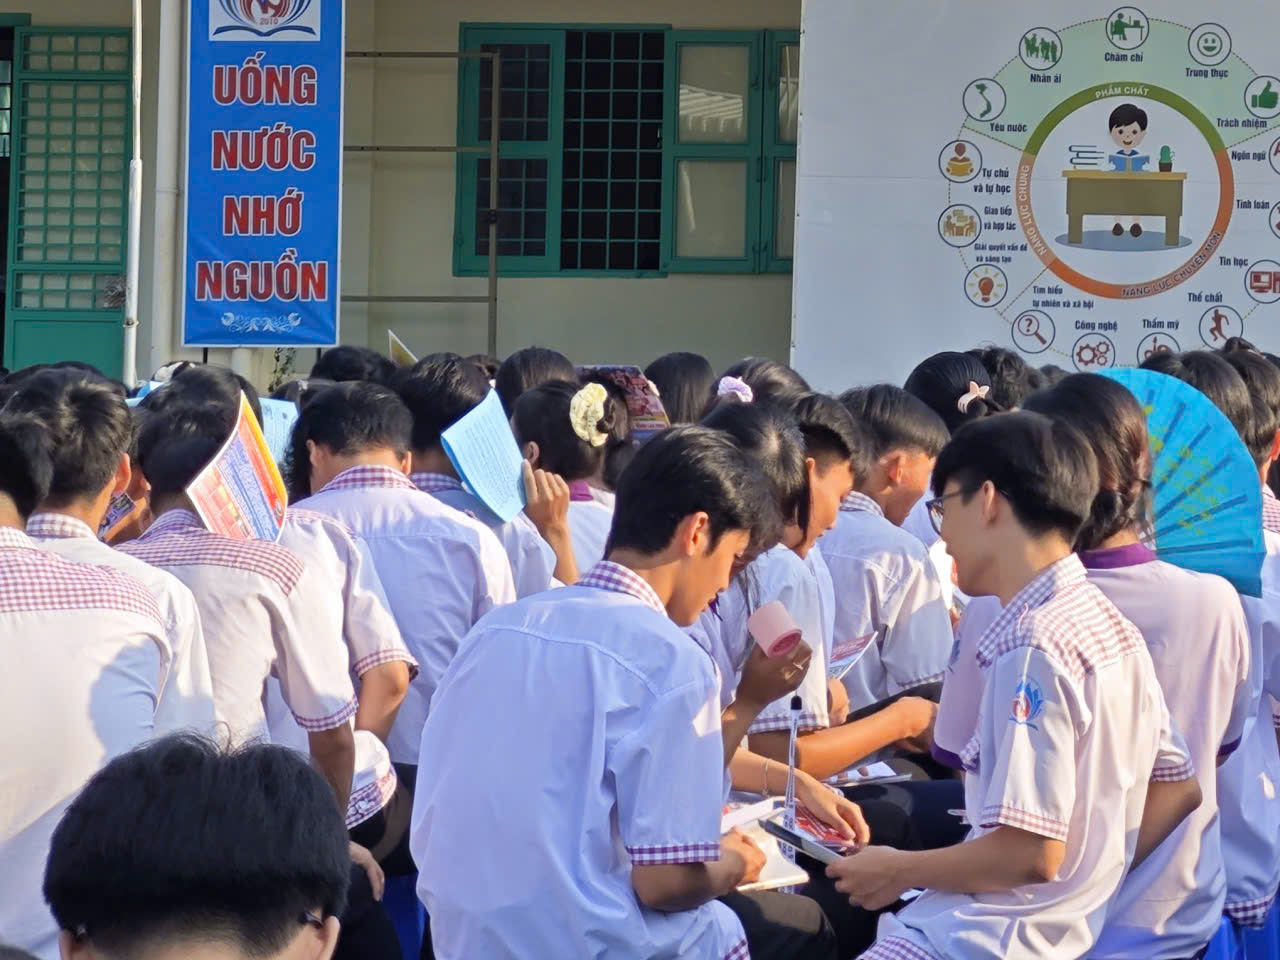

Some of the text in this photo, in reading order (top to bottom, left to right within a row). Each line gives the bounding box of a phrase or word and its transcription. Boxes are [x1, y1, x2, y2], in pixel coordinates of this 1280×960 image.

[260, 18, 279, 26] 2010
[212, 51, 318, 106] UỐNG
[1186, 68, 1208, 78] Trung
[1217, 118, 1267, 130] Trách nhiệm
[210, 123, 317, 171] NƯỚC
[973, 184, 983, 193] và
[996, 183, 1011, 195] học
[223, 187, 304, 237] NHỚ
[1219, 256, 1249, 268] Tin học
[195, 248, 329, 302] NGUỒN
[1097, 320, 1118, 332] nghệ
